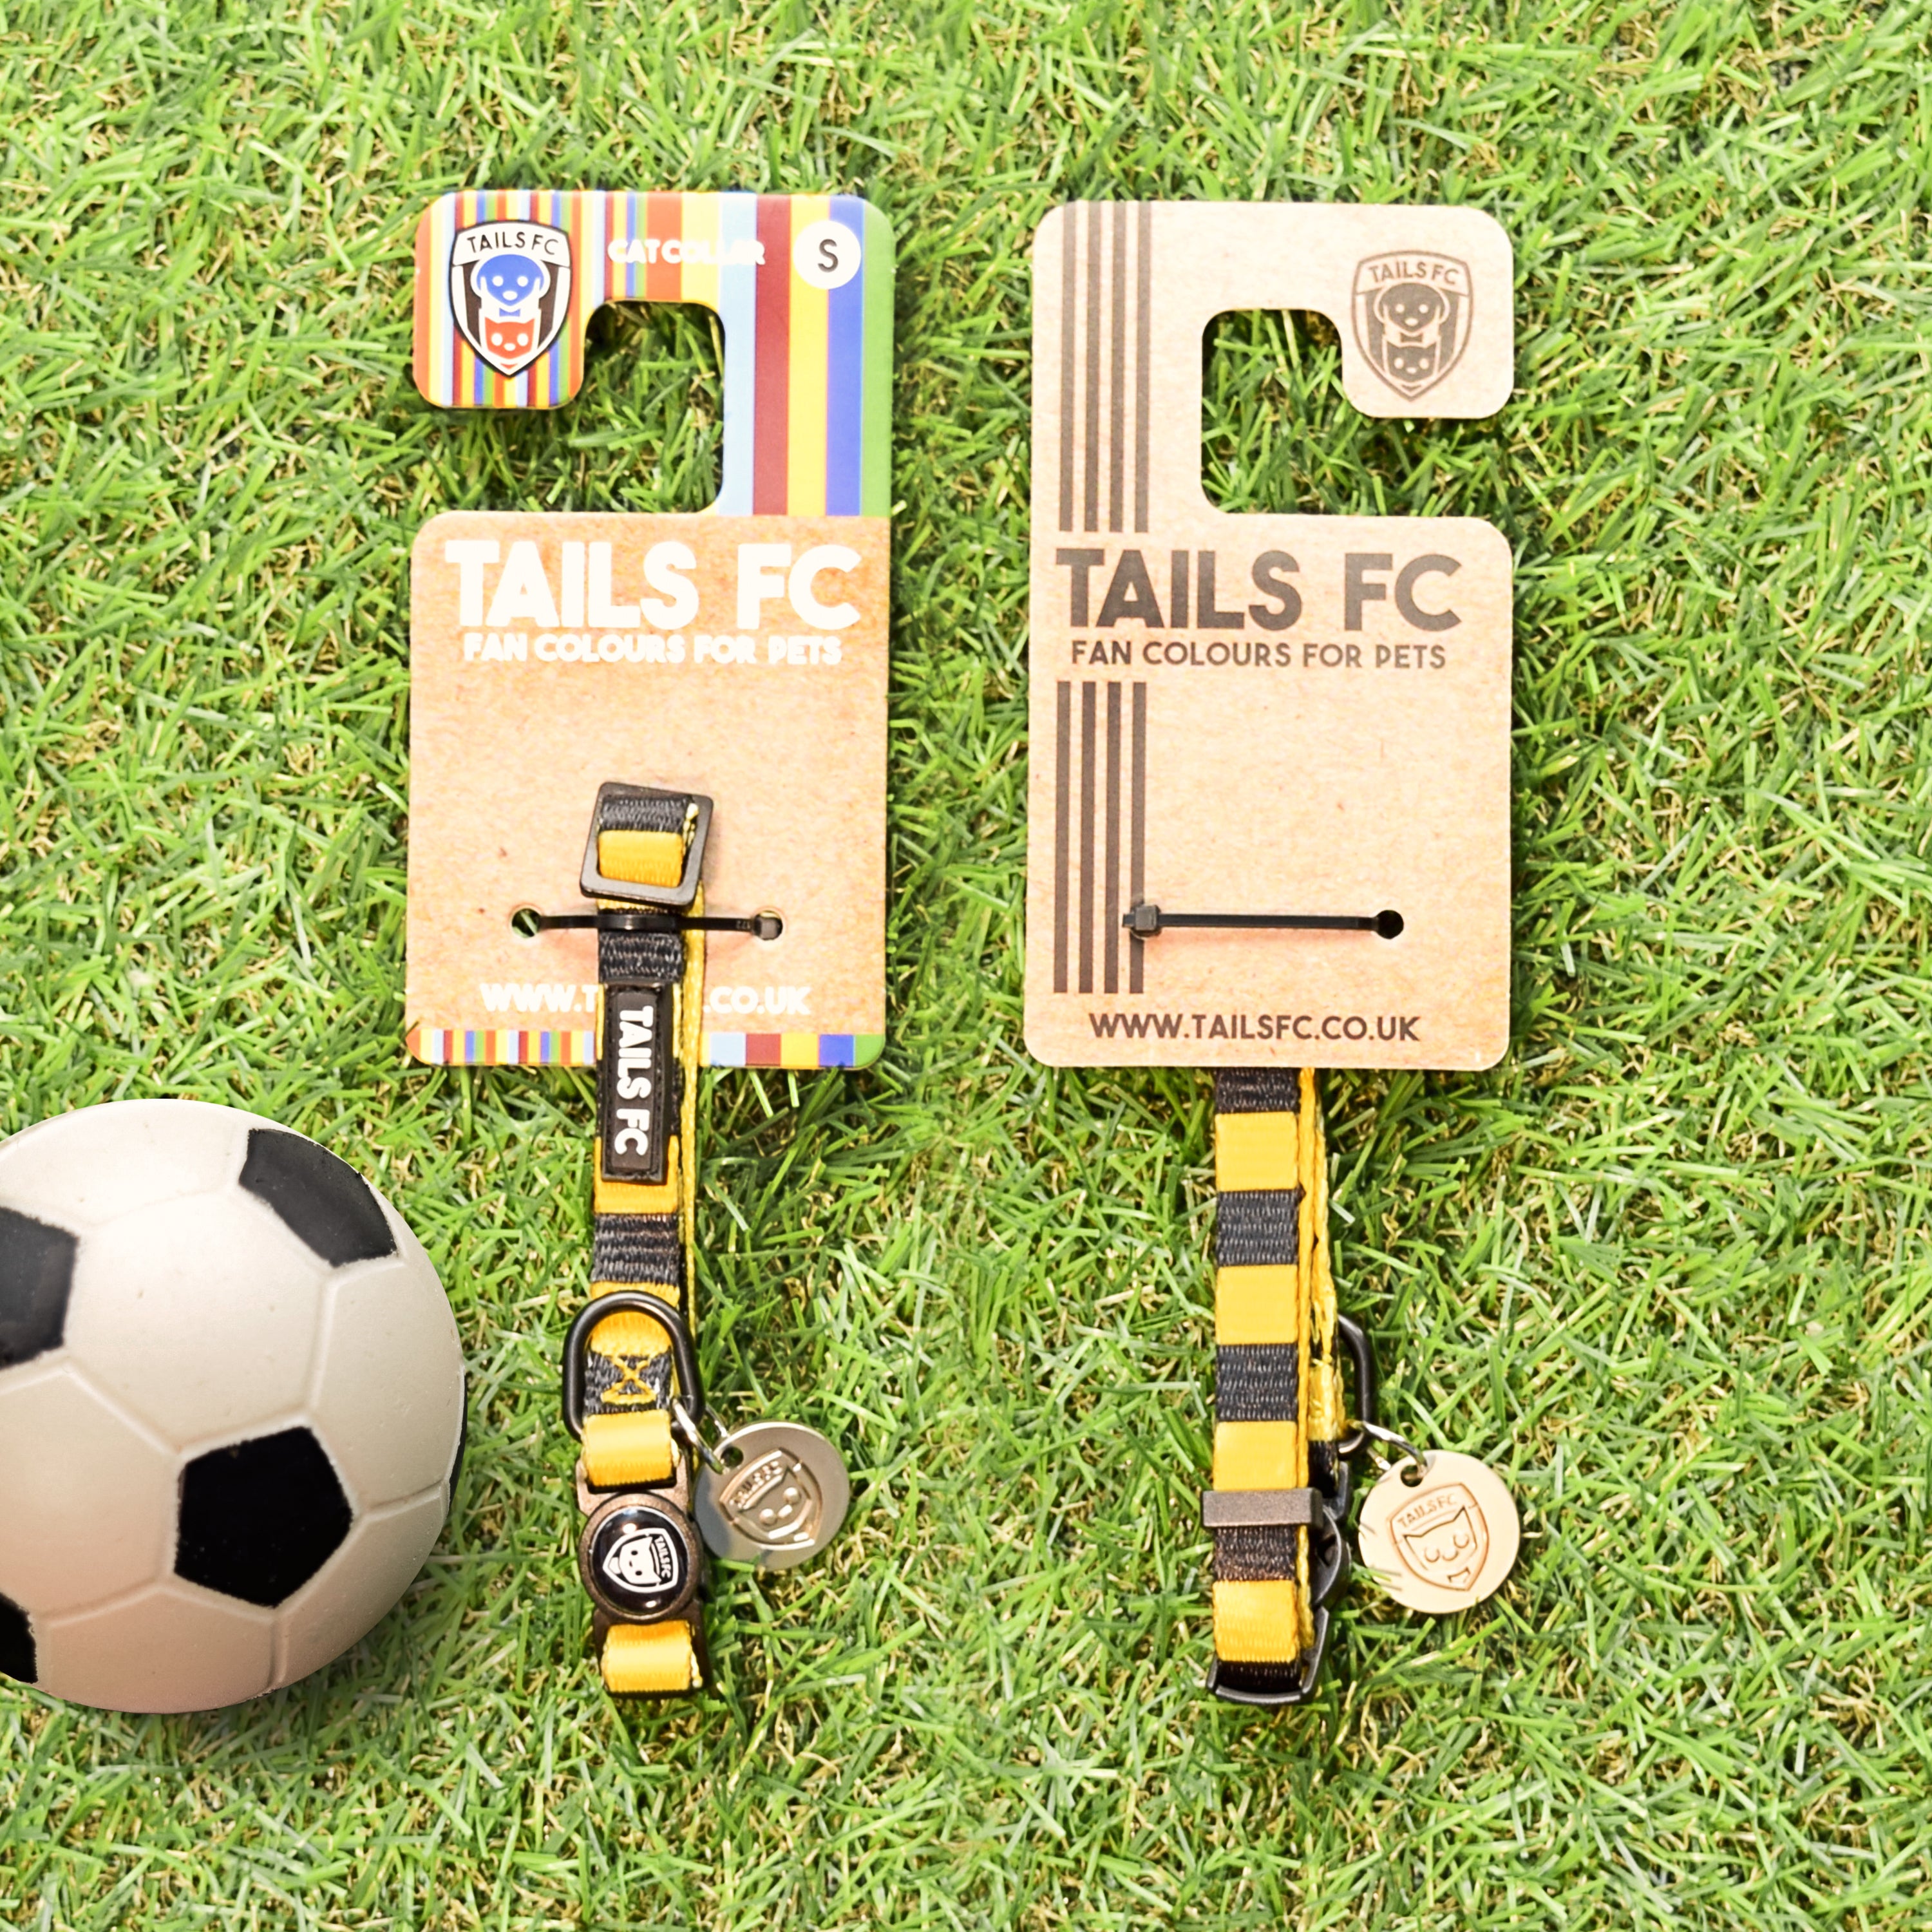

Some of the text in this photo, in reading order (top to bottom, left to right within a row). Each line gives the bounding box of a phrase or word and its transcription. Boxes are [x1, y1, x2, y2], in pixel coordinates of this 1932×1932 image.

[467, 231, 559, 255] TAILS FC
[607, 239, 661, 264] CAT
[817, 238, 839, 273] S
[1368, 261, 1459, 285] TAILS FC
[444, 540, 861, 630] TAILS FC
[1056, 548, 1463, 631] TAILS FC
[464, 632, 842, 665] FAN COLOURS FOR PETS
[1071, 640, 1446, 668] FAN COLOURS FOR PETS
[1088, 1013, 1421, 1041] WWW.TAILSFC.CO.UK
[614, 1005, 654, 1156] TAILS FC
